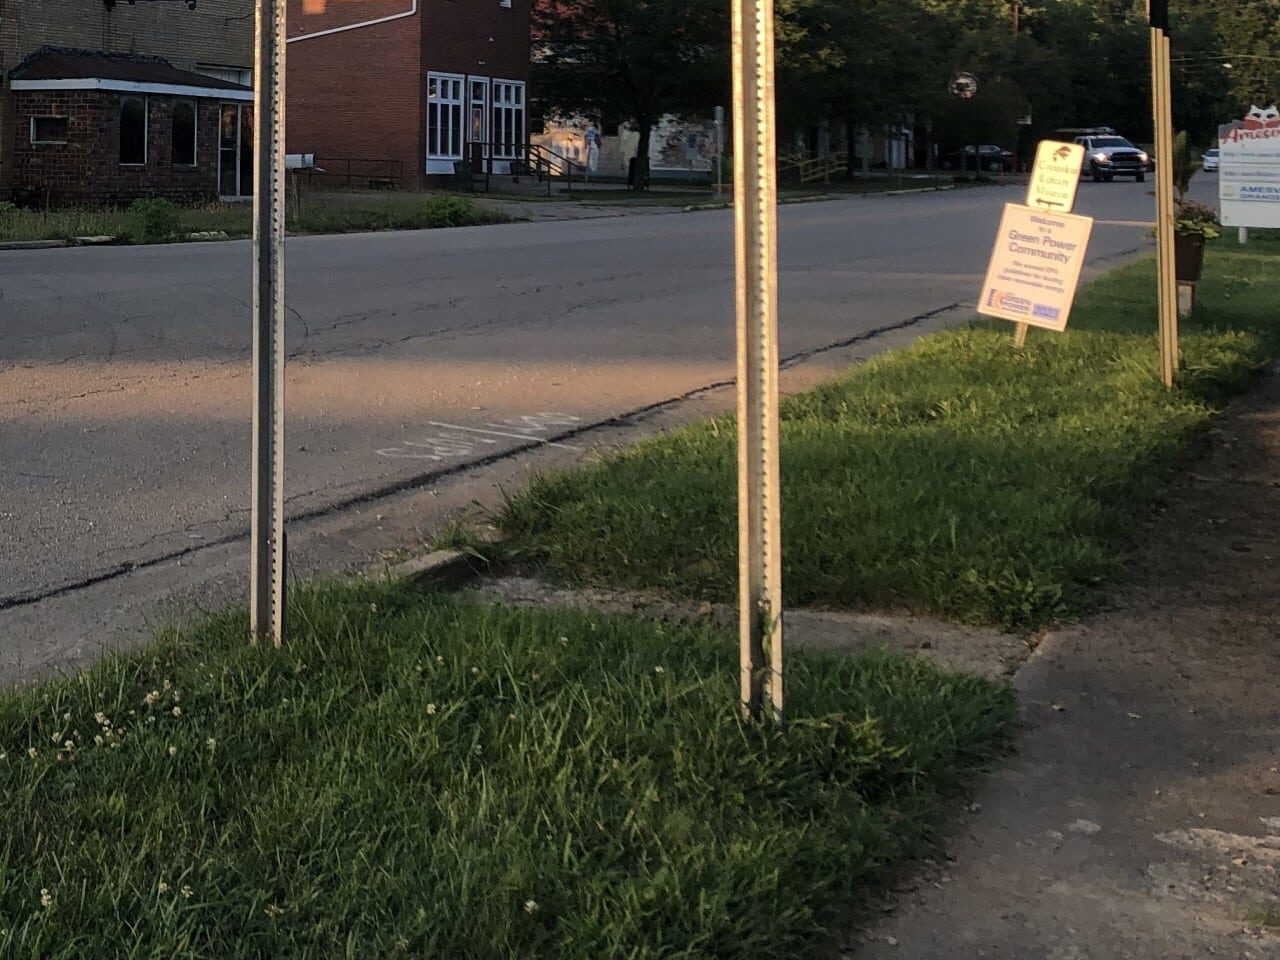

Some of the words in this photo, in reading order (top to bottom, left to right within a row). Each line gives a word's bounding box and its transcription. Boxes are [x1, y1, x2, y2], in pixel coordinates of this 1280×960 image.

[1030, 215, 1065, 228] Welcome
[1009, 229, 1040, 246] Green
[1042, 236, 1078, 251] Power
[1009, 242, 1071, 264] Community
